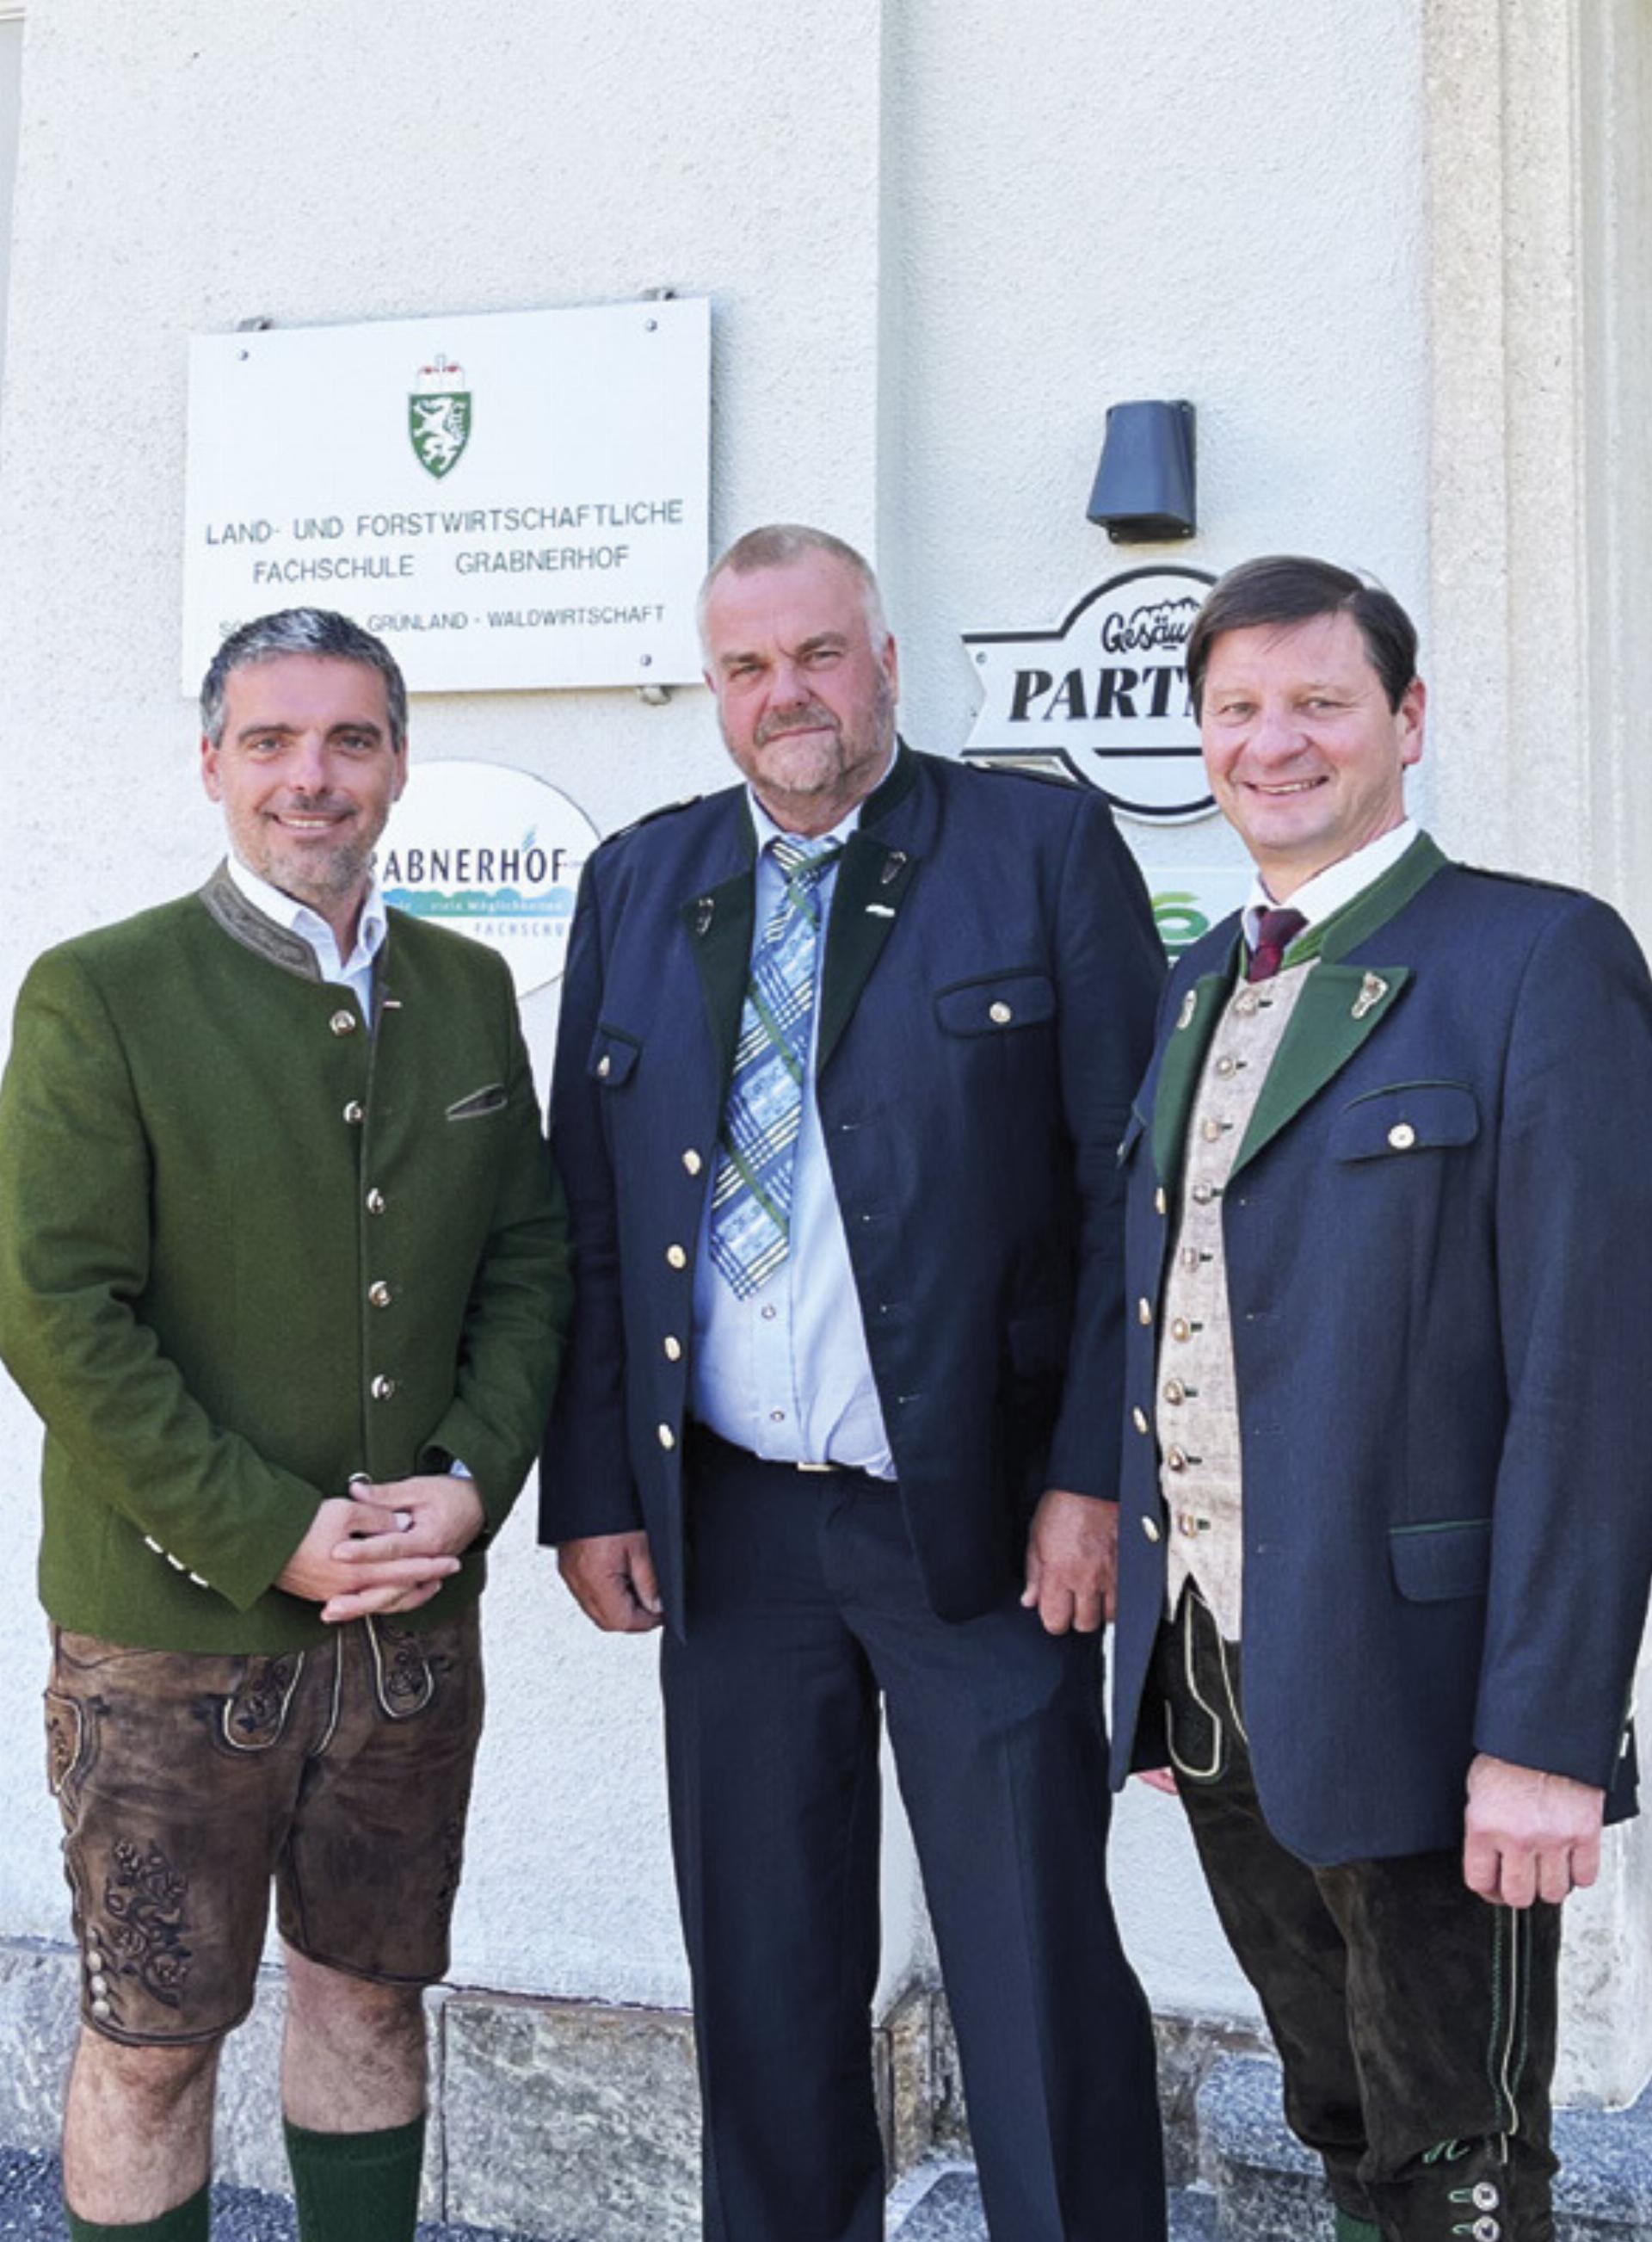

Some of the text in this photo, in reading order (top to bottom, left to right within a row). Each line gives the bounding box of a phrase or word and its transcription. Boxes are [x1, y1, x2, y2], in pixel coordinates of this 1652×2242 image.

[206, 499, 683, 546] LAND- UND FORSTWIRTSCHAFTLICHE
[253, 545, 629, 584] FACHSCHULE GRABNERHOF
[367, 609, 469, 633] GRÜNLAND
[487, 605, 665, 627] WALDWIRTSCHAFT
[1101, 611, 1194, 655] Gesäu
[1008, 664, 1193, 723] PART
